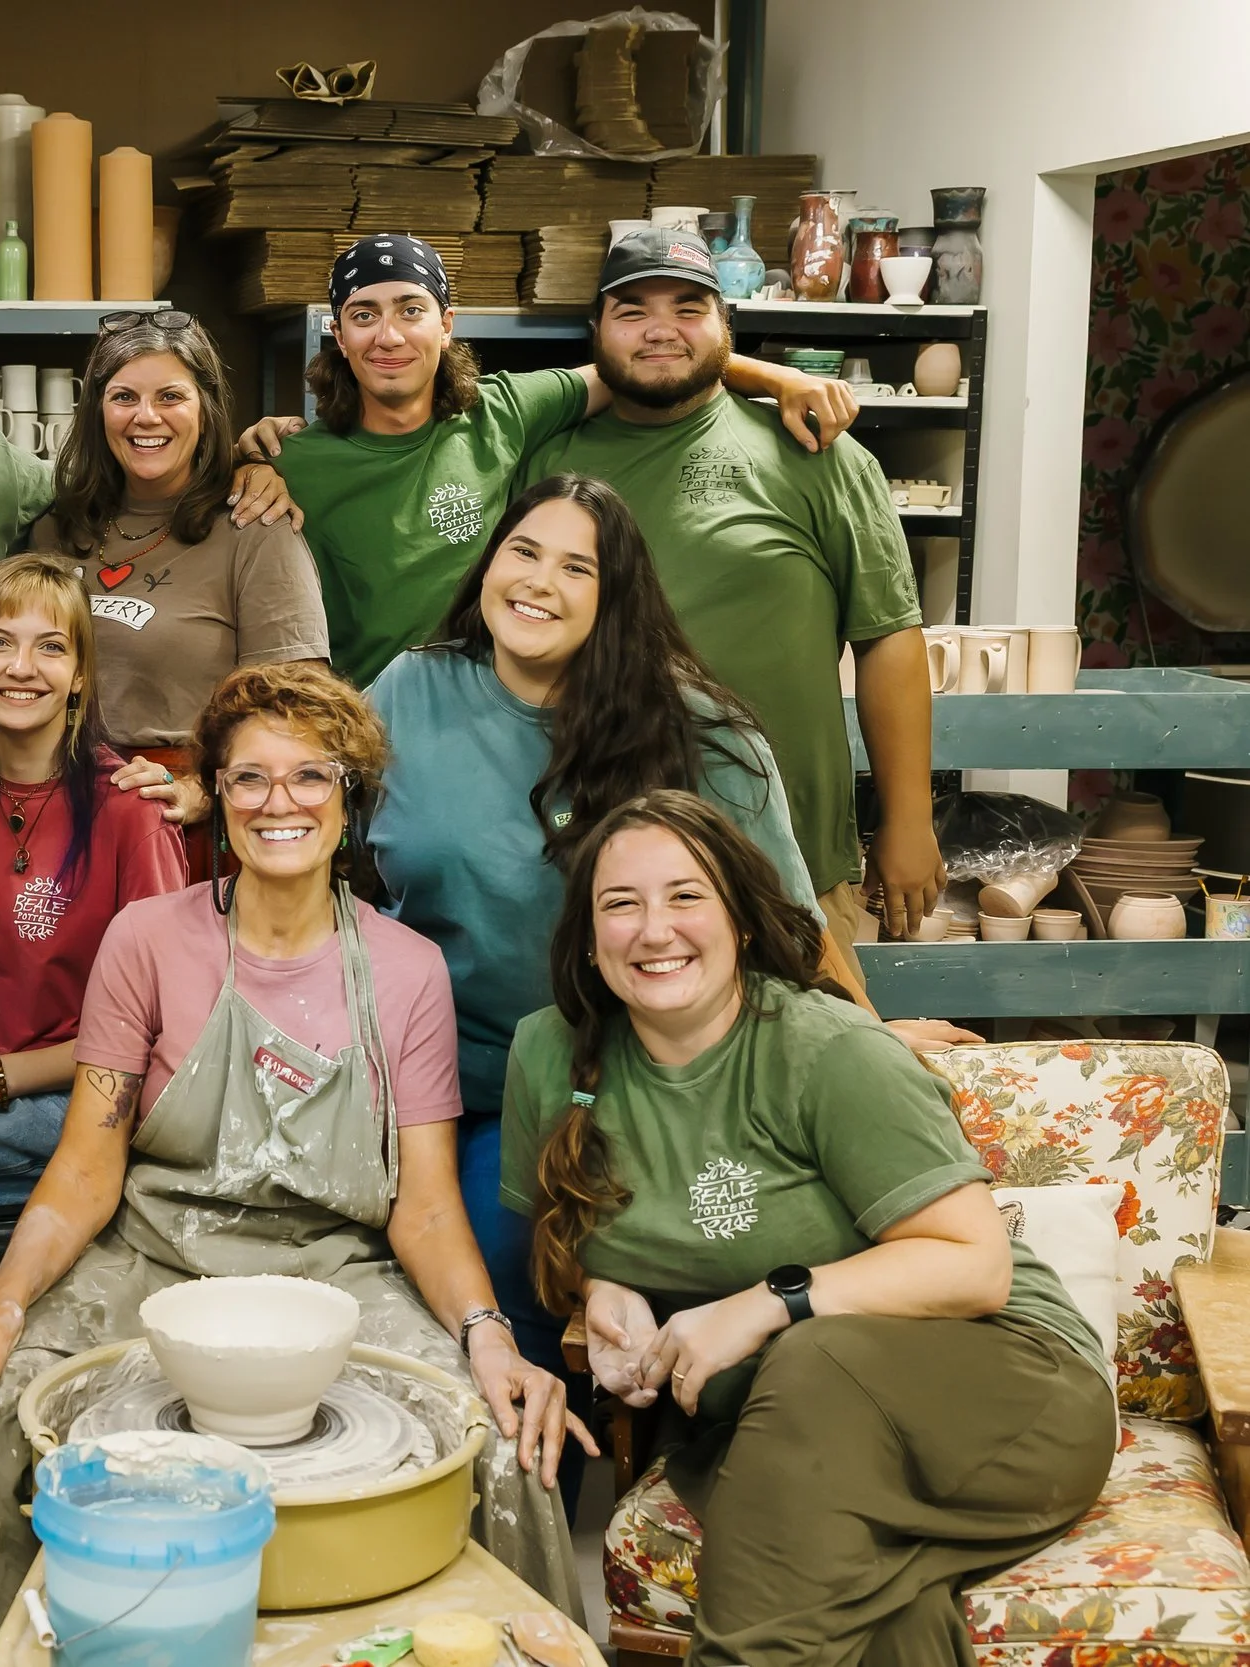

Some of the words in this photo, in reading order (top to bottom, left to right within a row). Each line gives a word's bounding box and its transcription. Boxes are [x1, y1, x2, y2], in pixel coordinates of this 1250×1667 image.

[678, 464, 747, 483] BEALE
[687, 480, 741, 489] POTTERY
[428, 497, 483, 527] BEALE
[440, 511, 481, 530] POTTERY
[13, 893, 66, 915] BEALE
[17, 911, 58, 925] POTTERY
[688, 1178, 759, 1211] BEALE
[696, 1197, 755, 1218] POTTERY
